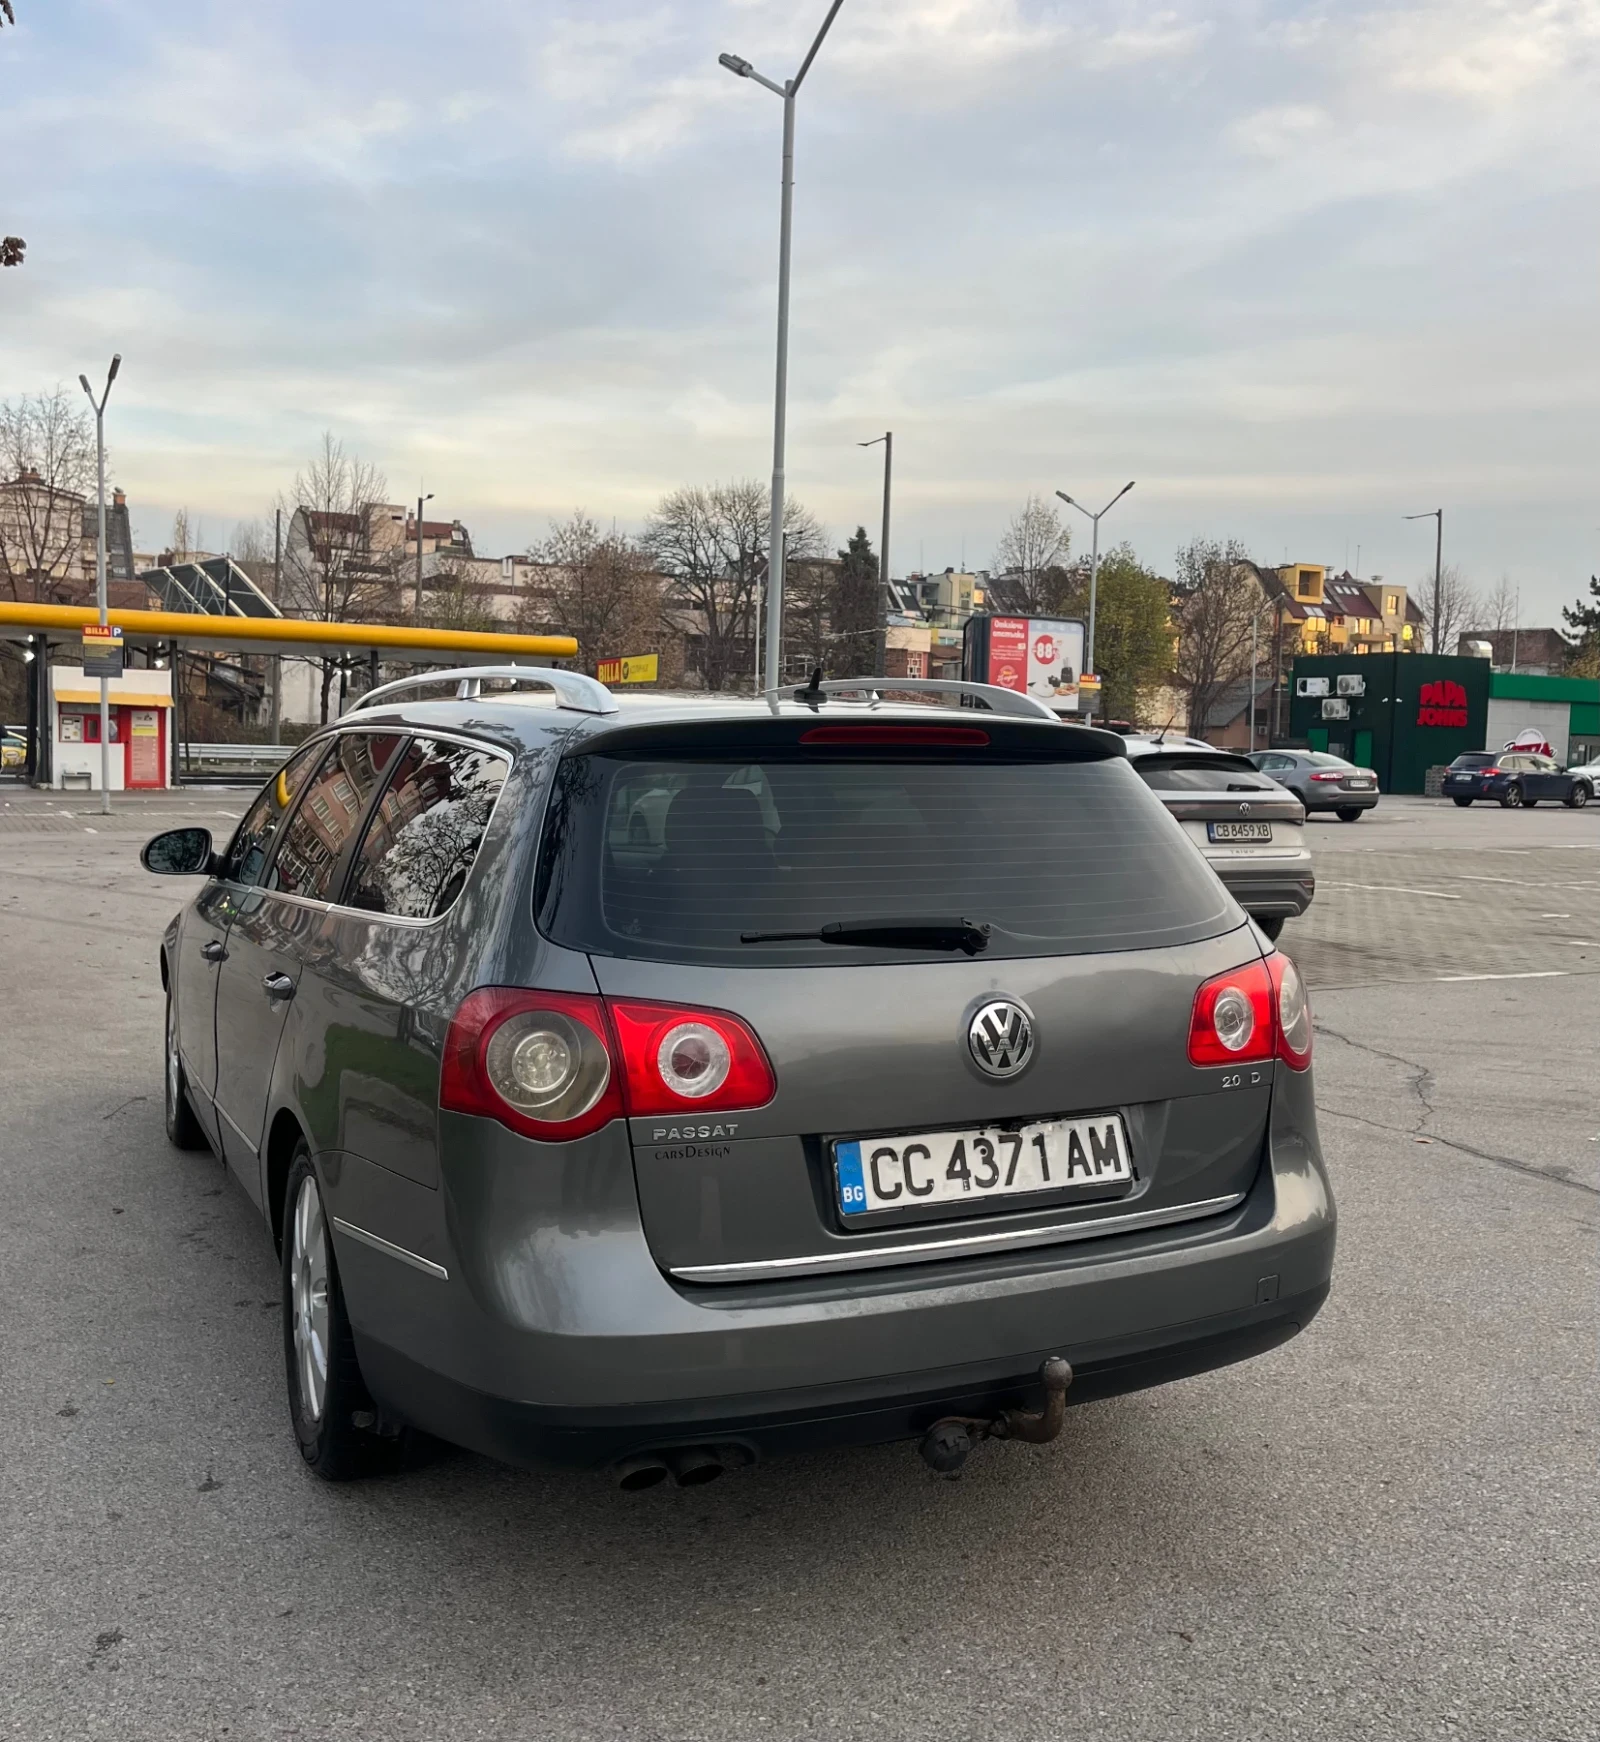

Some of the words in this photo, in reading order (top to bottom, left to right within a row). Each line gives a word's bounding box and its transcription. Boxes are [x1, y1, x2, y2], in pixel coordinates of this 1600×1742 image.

[85, 626, 110, 635] BILLA
[113, 627, 122, 637] P
[598, 662, 620, 683] BILLA
[1420, 680, 1467, 707] PAPA
[1417, 708, 1468, 727] JOHNS
[1216, 824, 1230, 837] CB
[1231, 824, 1255, 837] 8459
[1257, 824, 1269, 837] XB
[1251, 1072, 1261, 1084] D
[653, 1124, 738, 1140] PASSAT
[870, 1144, 934, 1200] CC
[946, 1132, 1051, 1190] 4371
[1067, 1124, 1122, 1179] AM
[842, 1184, 864, 1203] BG
